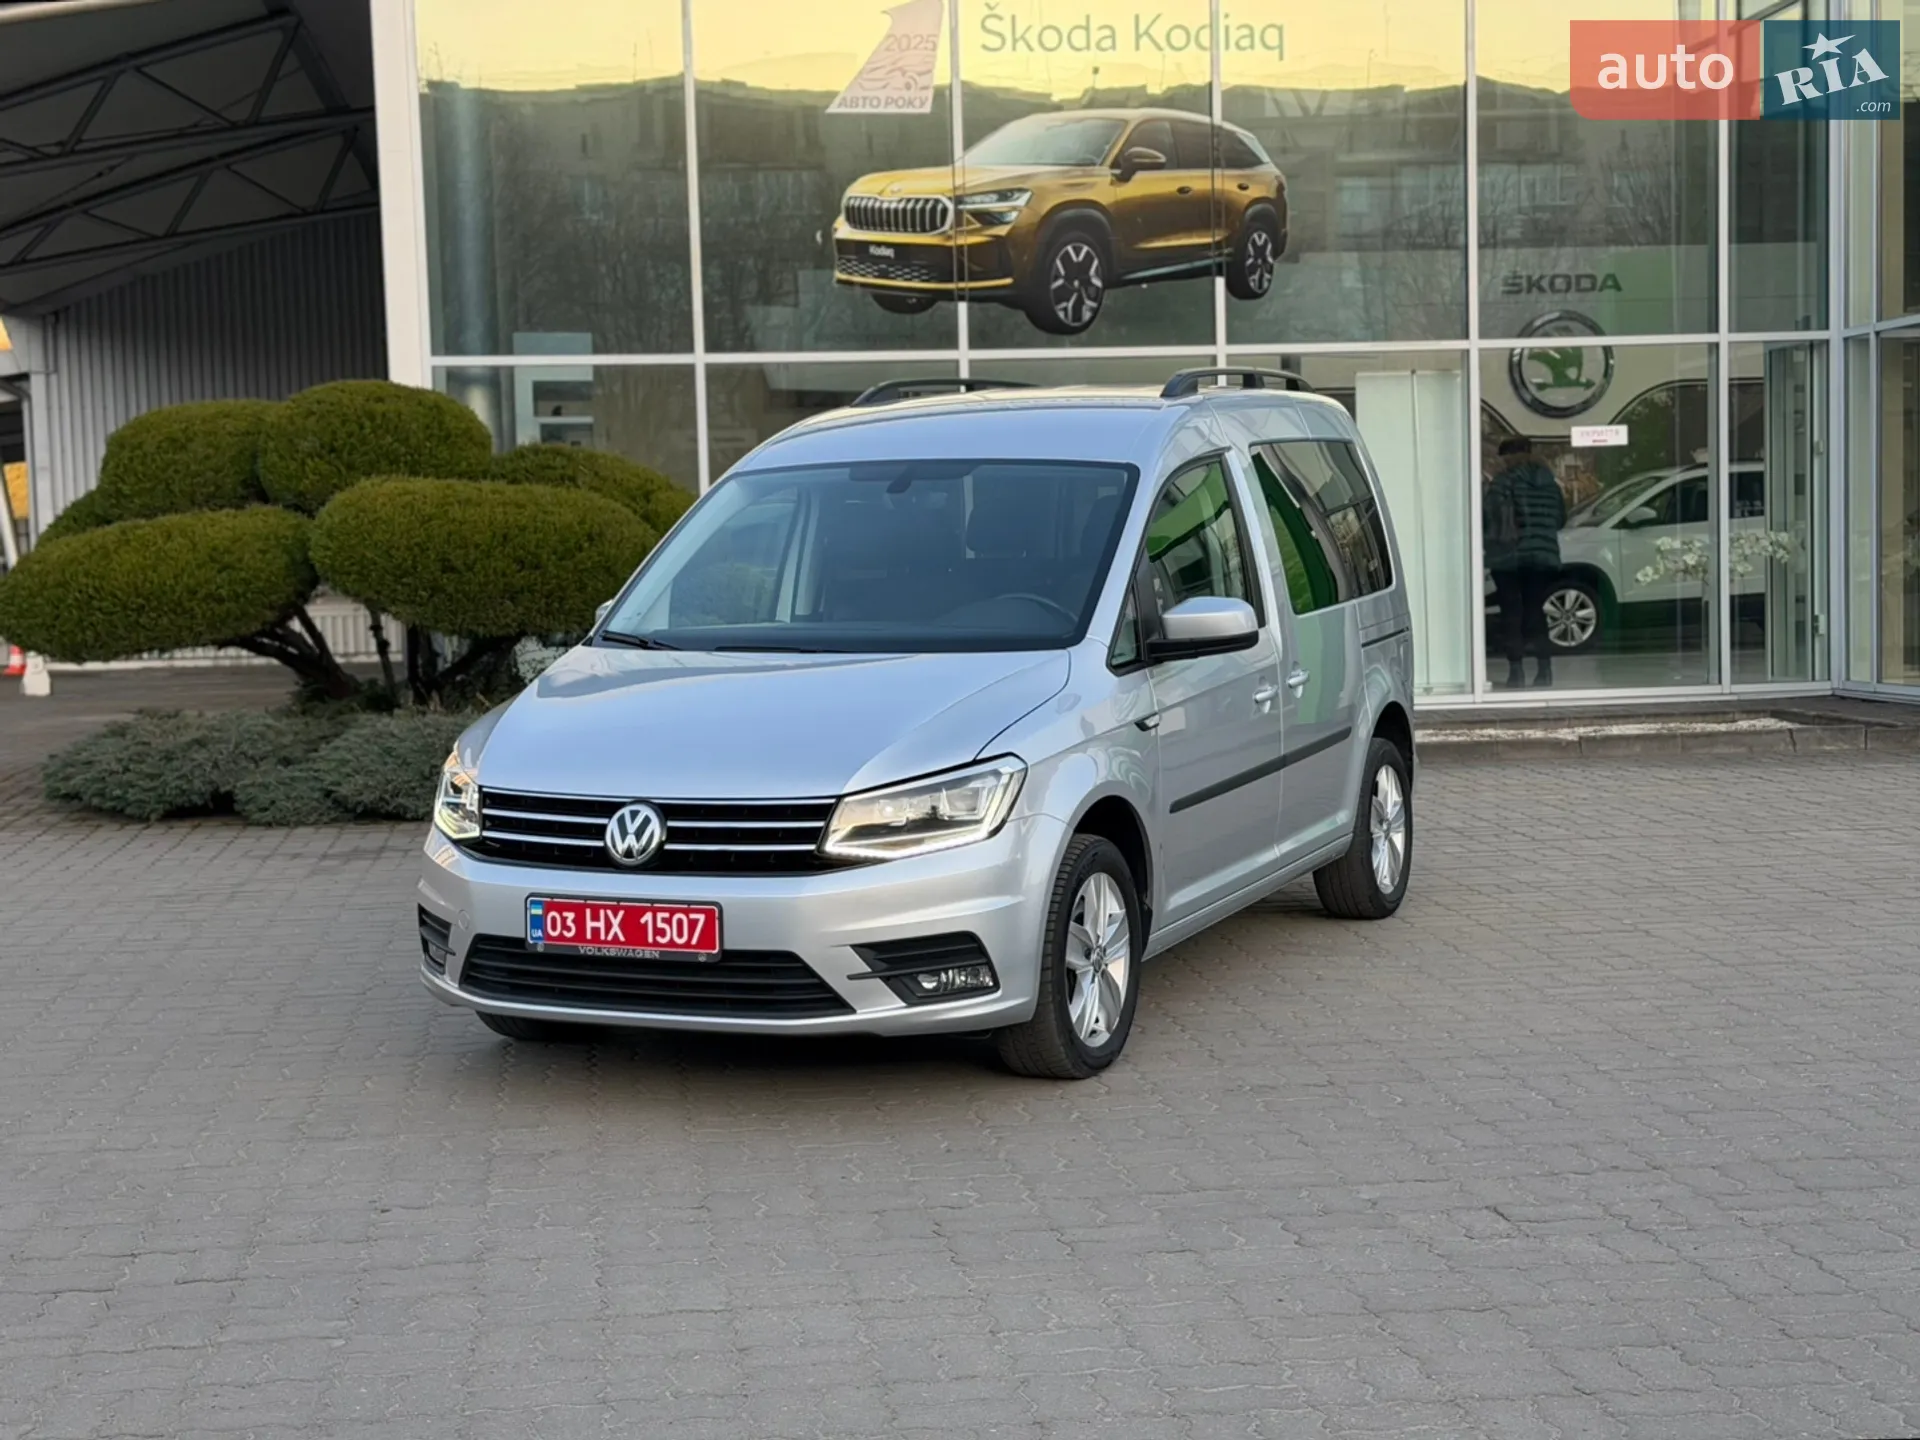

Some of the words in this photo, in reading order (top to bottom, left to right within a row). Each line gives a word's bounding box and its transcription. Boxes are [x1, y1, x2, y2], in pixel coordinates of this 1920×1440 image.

[884, 33, 938, 52] 2025
[980, 1, 1117, 53] Škoda
[1134, 12, 1285, 62] Kodiaq
[837, 95, 881, 110] АВТО
[883, 95, 929, 110] РОКУ
[1500, 269, 1624, 295] ŠKODA
[531, 929, 543, 938] UA
[546, 911, 577, 938] 03
[585, 908, 626, 942] HX
[639, 911, 706, 946] 1507
[578, 945, 661, 960] VOLKSWAGEN
